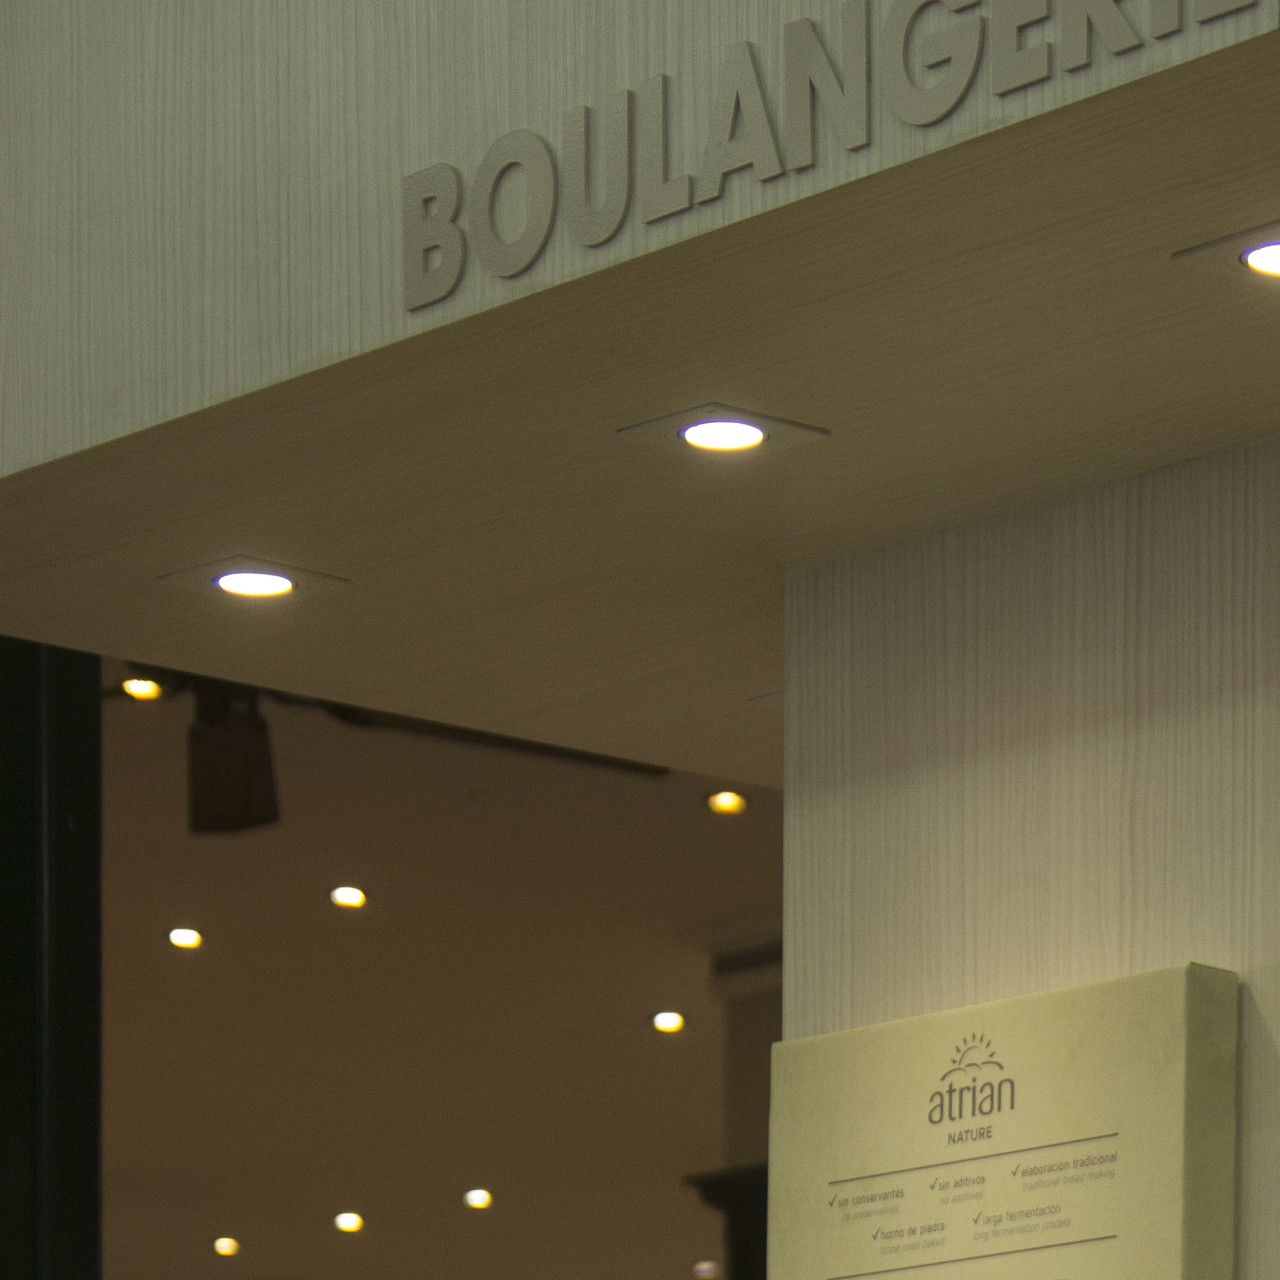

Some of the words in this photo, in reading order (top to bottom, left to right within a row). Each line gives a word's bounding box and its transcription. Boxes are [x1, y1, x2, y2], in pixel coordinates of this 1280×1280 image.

[928, 1077, 1015, 1124] atrian
[947, 1125, 993, 1145] NATURE
[1073, 1151, 1117, 1169] tradicional
[939, 1181, 950, 1191] sin
[953, 1173, 985, 1189] aditivos
[838, 1197, 849, 1208] sin
[852, 1188, 904, 1205] conservantes
[983, 1213, 1002, 1227] larga
[881, 1227, 904, 1241] horno
[907, 1225, 916, 1236] de
[920, 1221, 945, 1236] piedra
